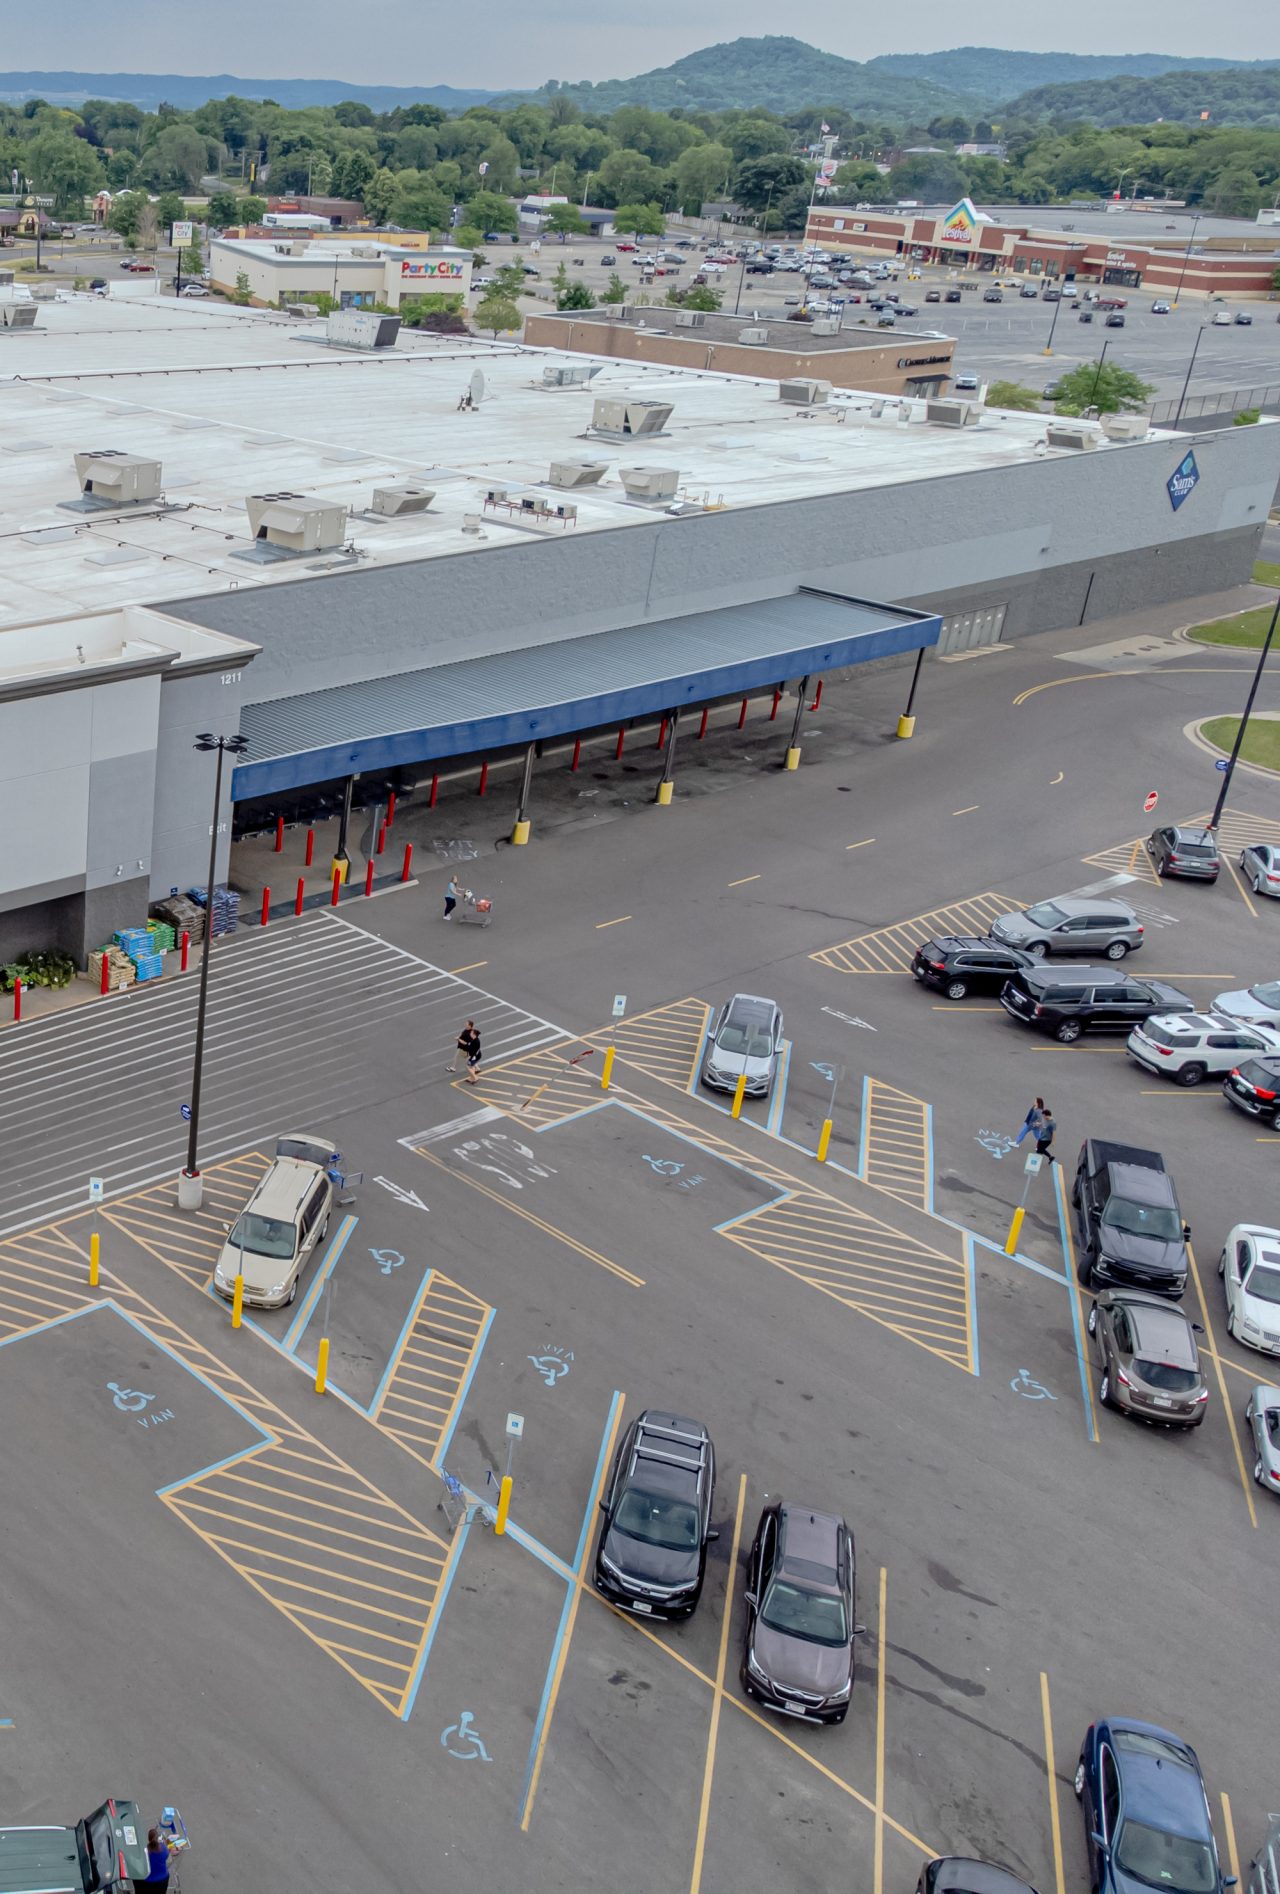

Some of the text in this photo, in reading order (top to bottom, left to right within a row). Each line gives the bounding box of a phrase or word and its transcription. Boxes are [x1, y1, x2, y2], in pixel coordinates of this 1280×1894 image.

[401, 261, 463, 275] Party City
[1170, 474, 1197, 491] Sam's
[220, 671, 242, 685] 1211
[677, 1174, 708, 1190] VAN
[136, 1408, 176, 1429] VAN
